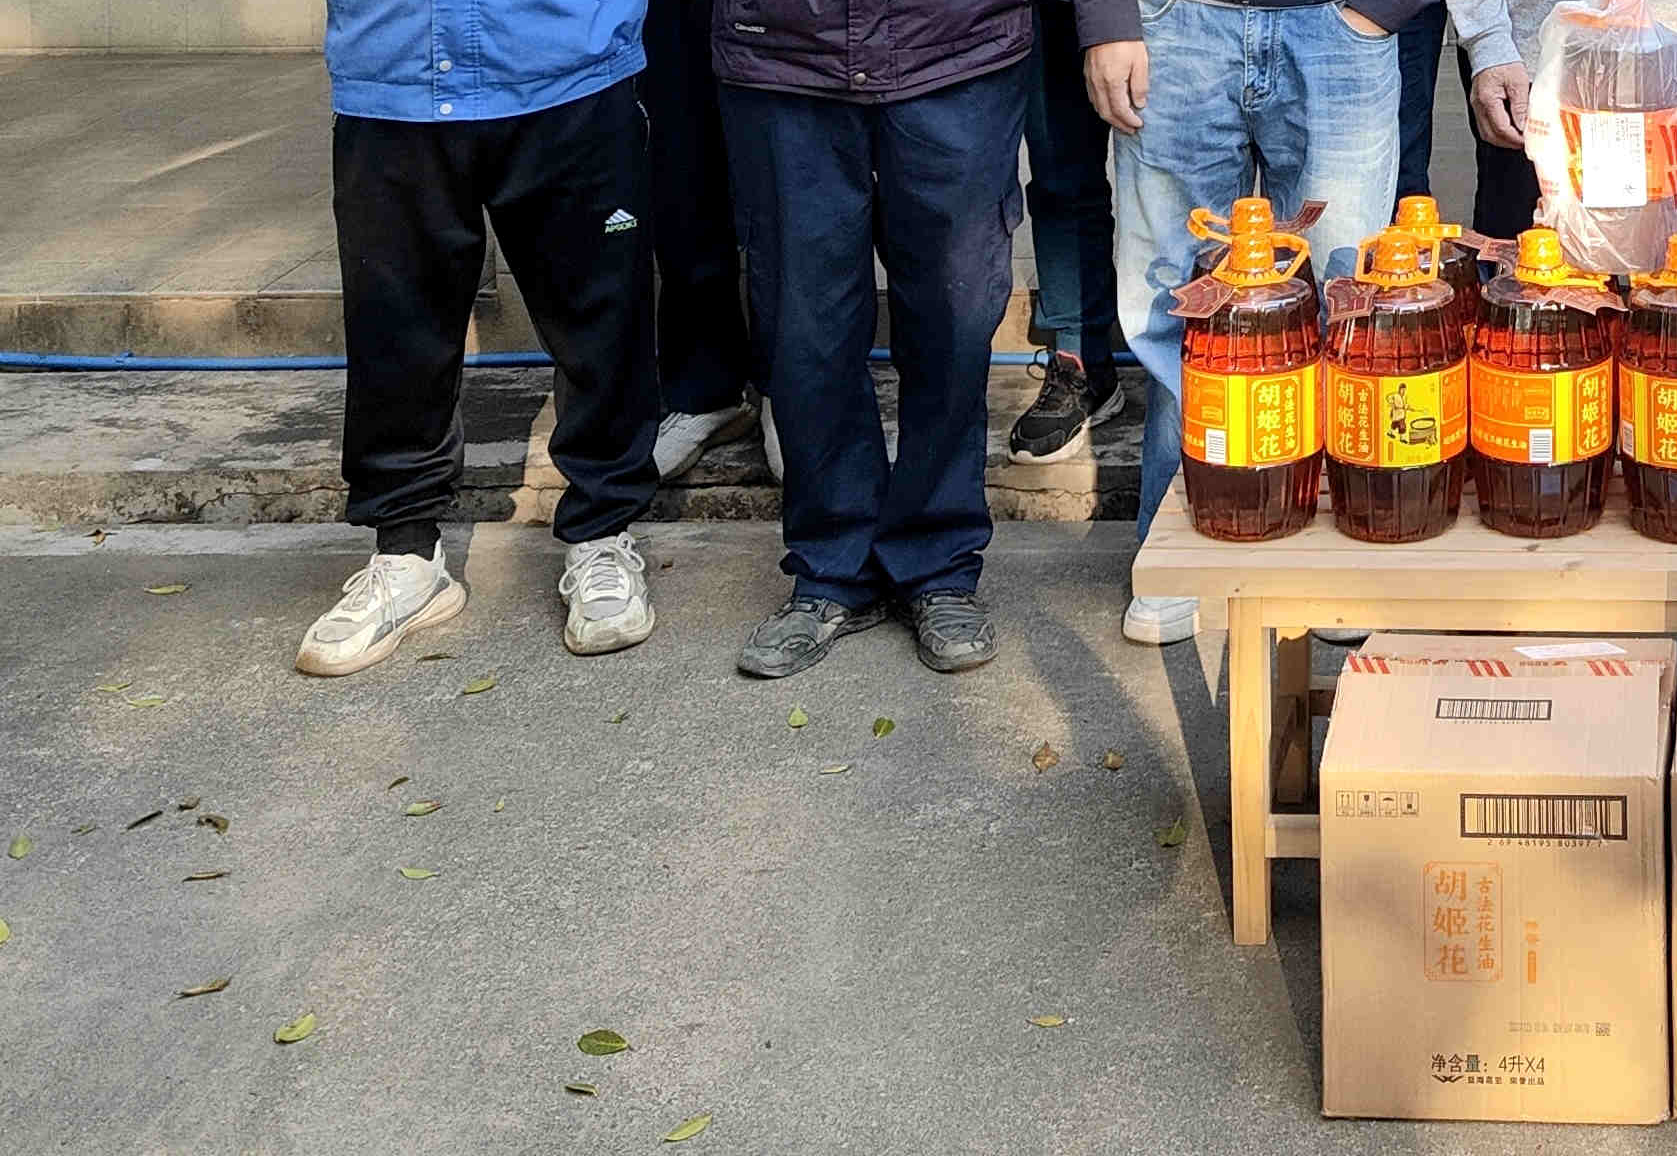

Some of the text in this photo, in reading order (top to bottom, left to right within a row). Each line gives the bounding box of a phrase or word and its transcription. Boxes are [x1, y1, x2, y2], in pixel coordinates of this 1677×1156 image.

[1257, 385, 1281, 457] 胡姬花
[1337, 380, 1355, 454] 胡姬花
[1358, 388, 1369, 453] 古法花生油
[1581, 375, 1599, 450] 胡姬花
[1433, 869, 1469, 975] 胡姬花
[1477, 877, 1495, 970] 古法花生油
